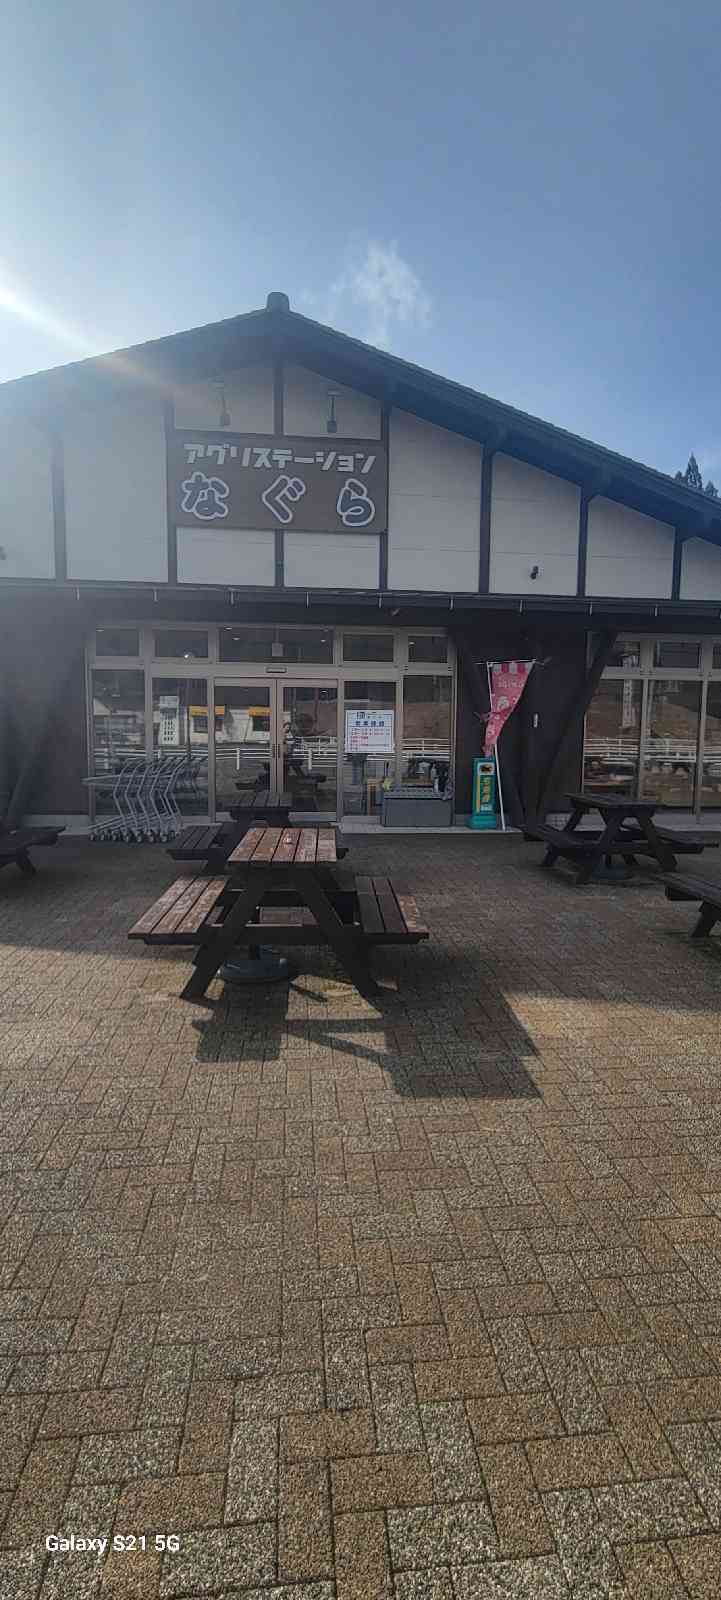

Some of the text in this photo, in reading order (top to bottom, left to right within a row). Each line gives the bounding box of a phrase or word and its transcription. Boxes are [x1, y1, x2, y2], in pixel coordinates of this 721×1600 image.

[184, 444, 376, 474] アグリステーション
[181, 471, 376, 526] なぐら
